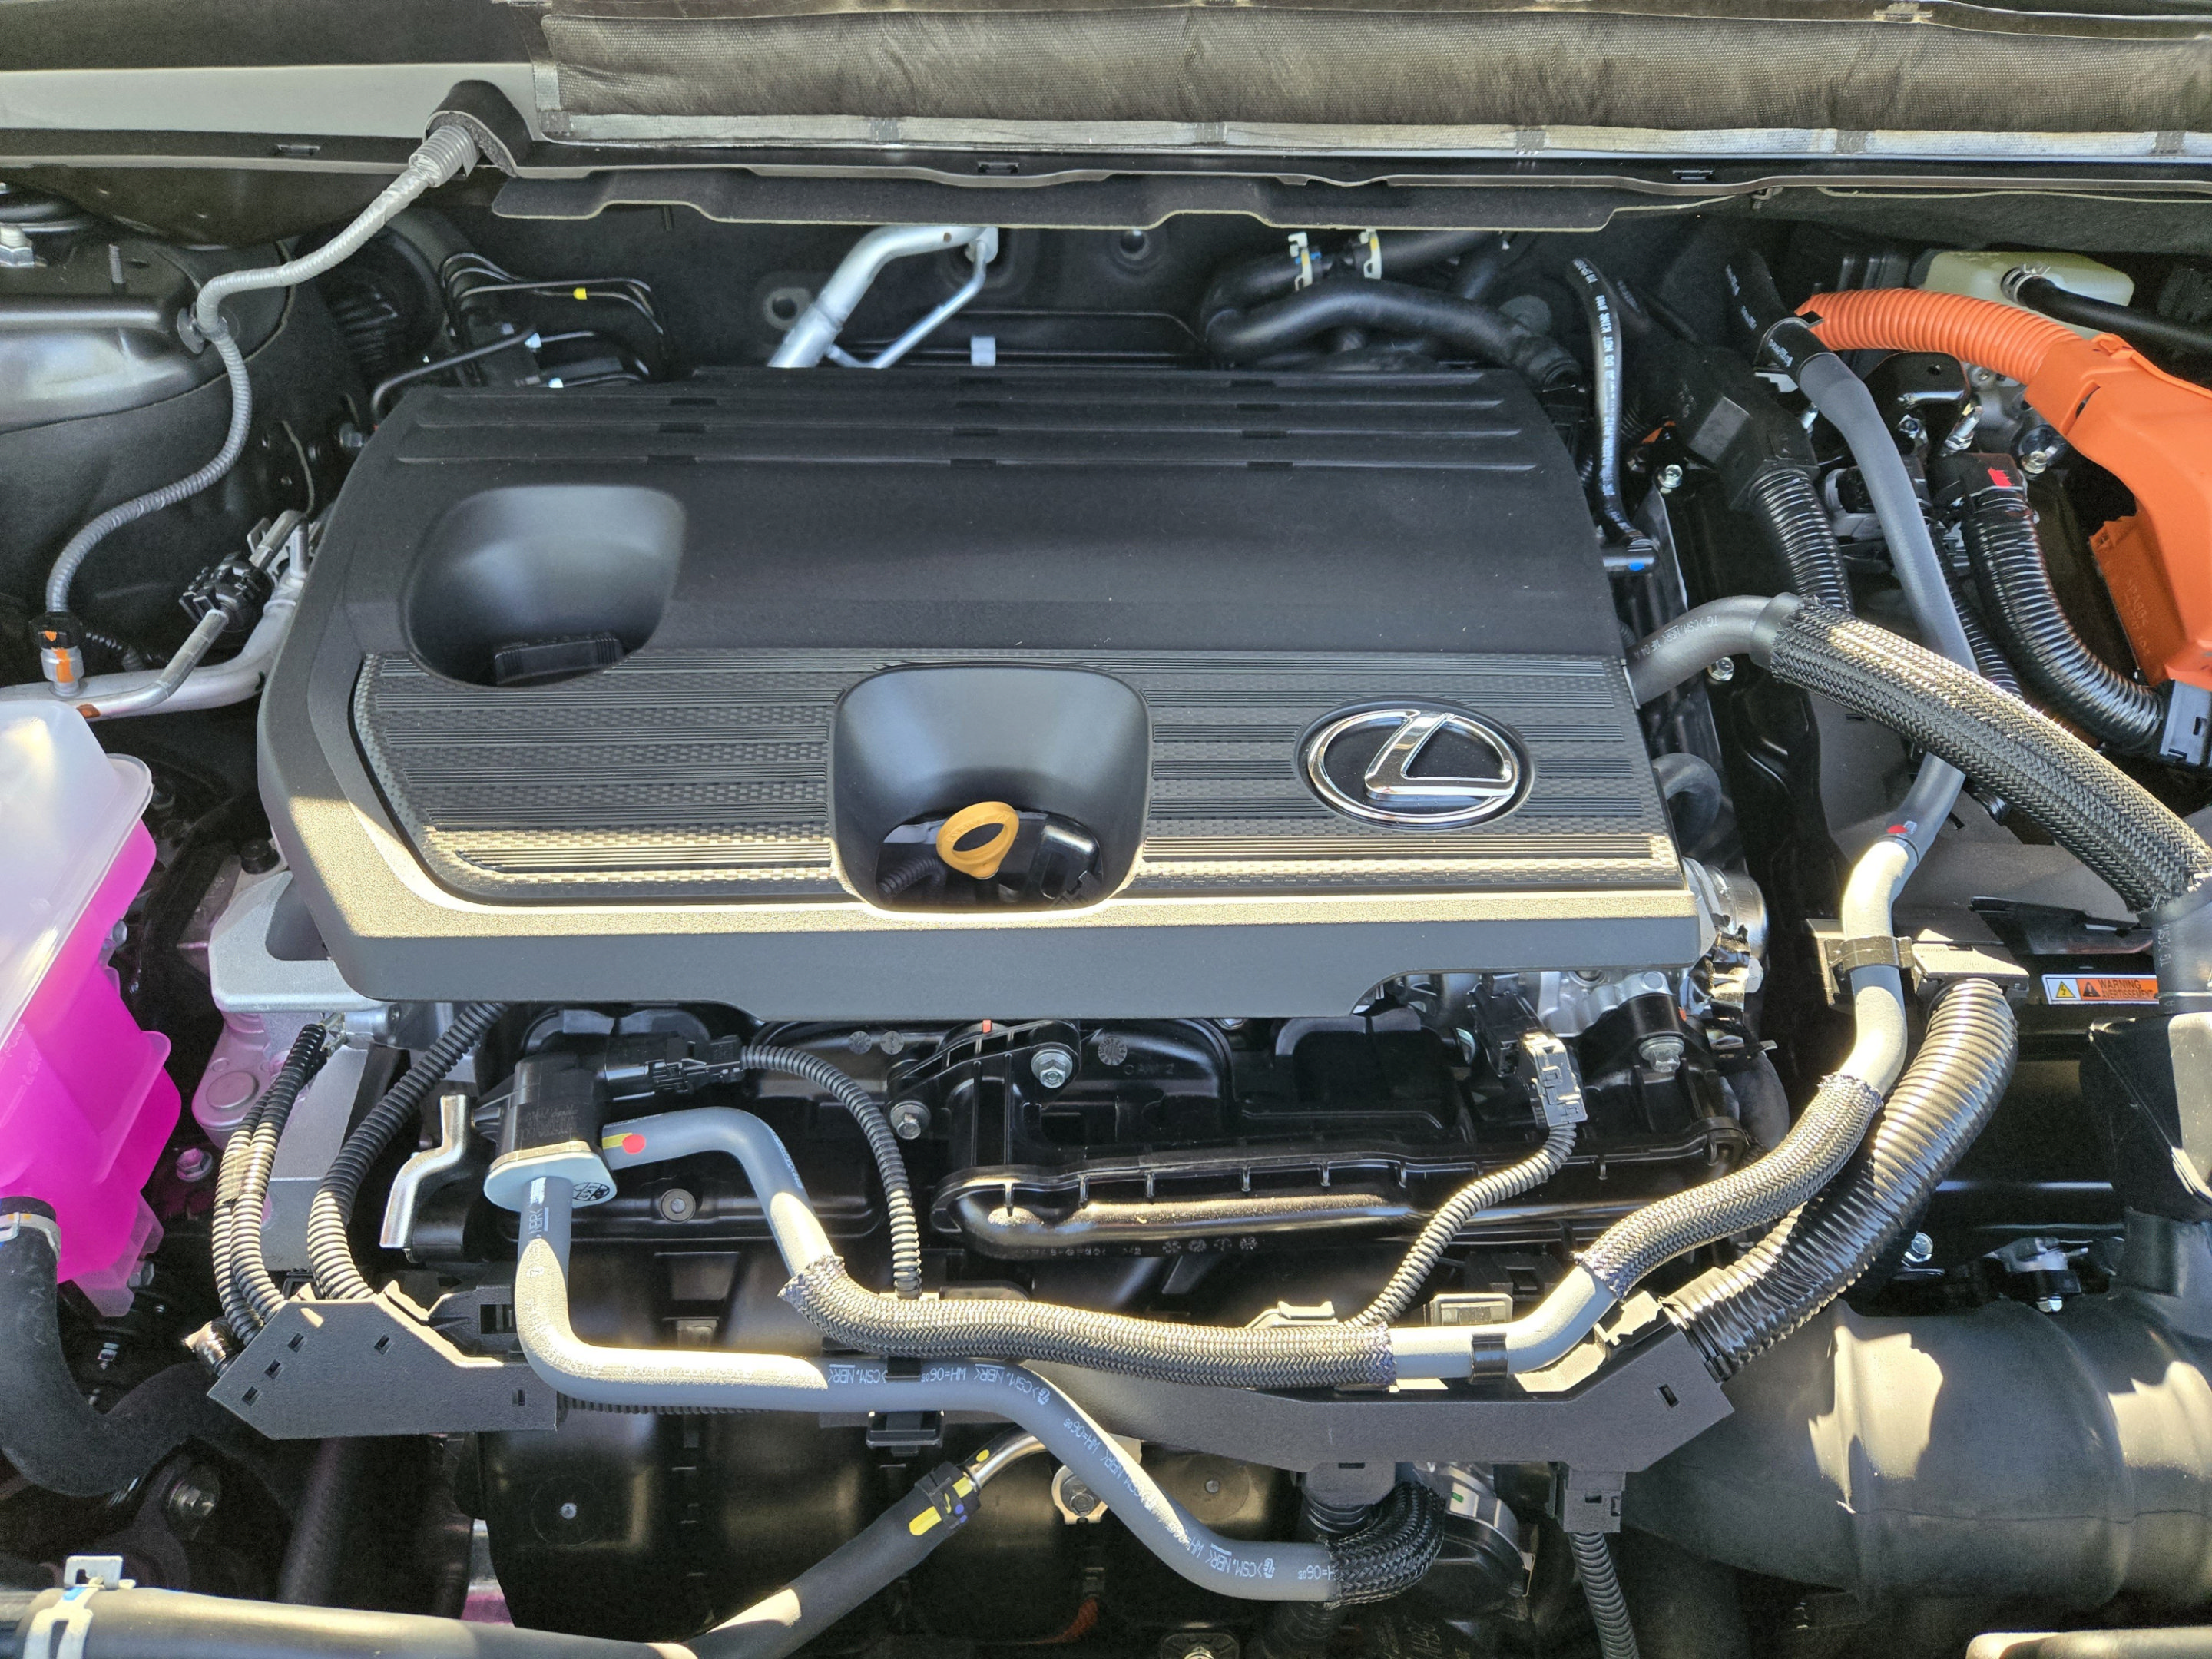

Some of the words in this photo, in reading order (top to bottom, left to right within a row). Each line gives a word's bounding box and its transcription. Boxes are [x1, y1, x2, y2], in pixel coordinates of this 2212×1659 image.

[1602, 336, 1614, 352] NOT
[2098, 979, 2142, 989] WARNING
[2101, 989, 2154, 999] AVERTISSEMENT
